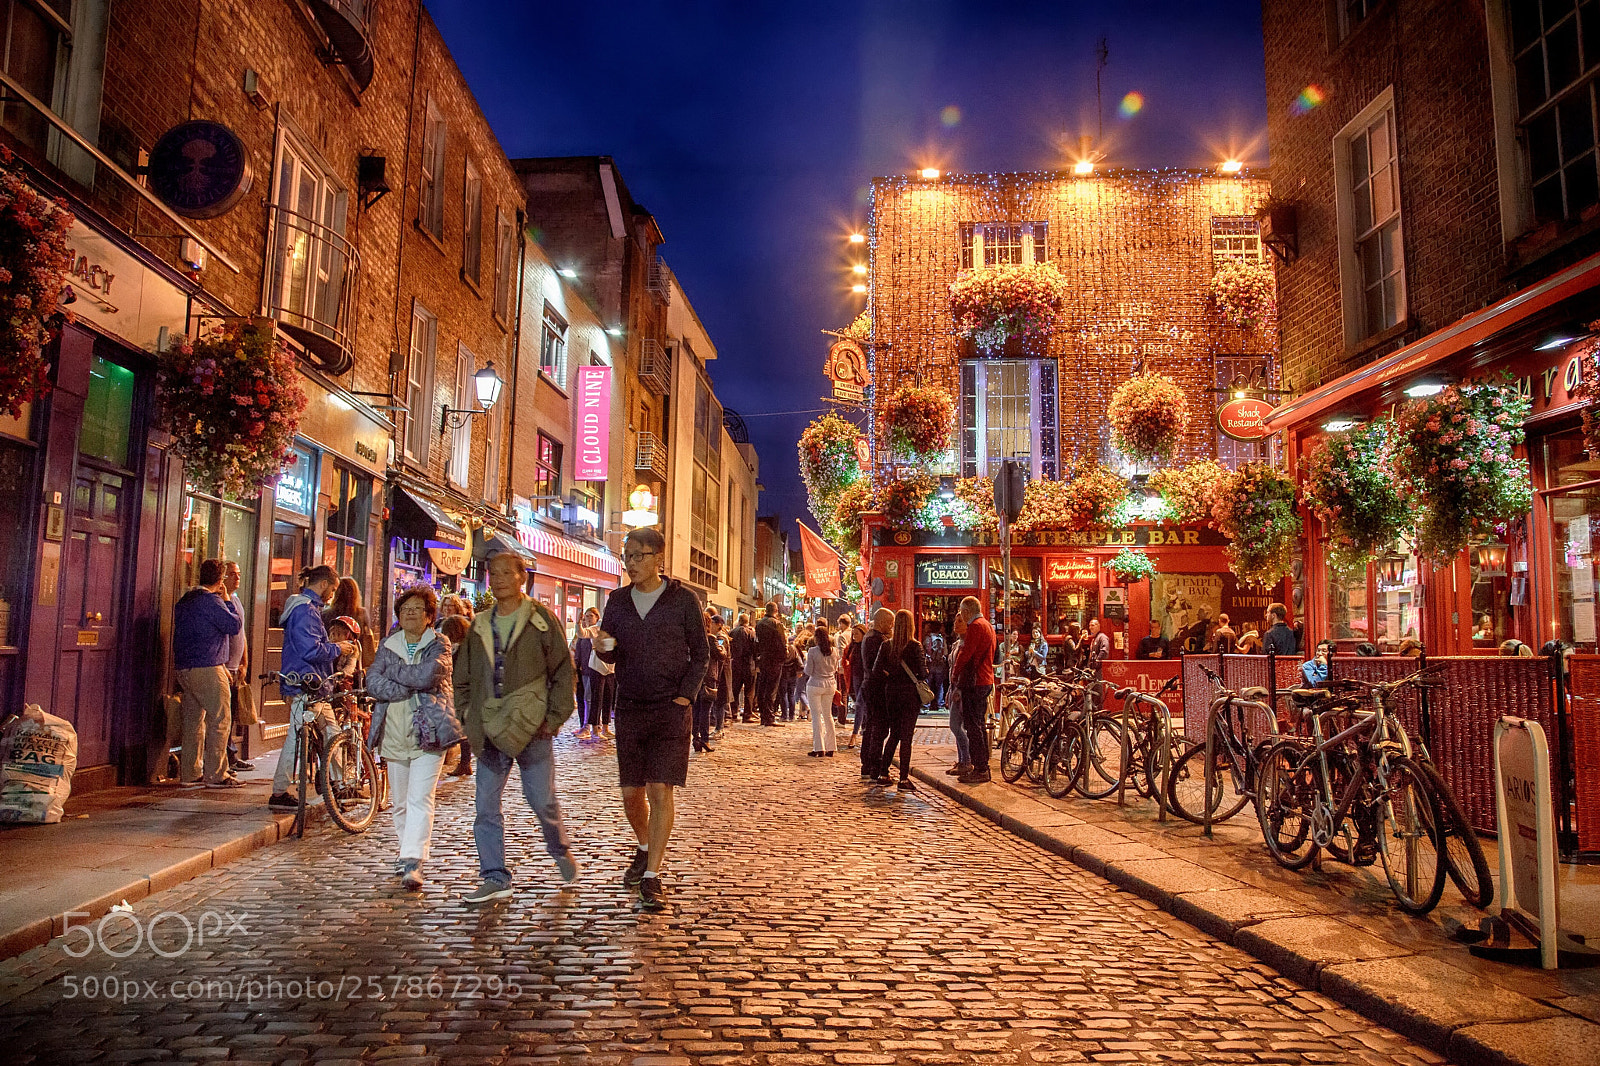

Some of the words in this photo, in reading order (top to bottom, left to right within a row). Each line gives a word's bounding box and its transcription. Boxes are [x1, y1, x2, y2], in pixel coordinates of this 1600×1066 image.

[585, 370, 605, 408] NINE
[1237, 405, 1261, 418] Shack
[1227, 419, 1263, 428] Restaura
[583, 413, 602, 464] CLOUD
[1035, 530, 1136, 545] TEMPLE
[1147, 530, 1200, 545] BAR
[1050, 561, 1095, 571] Traditional
[808, 570, 837, 579] TEMPLE
[923, 567, 970, 583] TOBACCO
[1049, 570, 1071, 580] Irish
[1072, 570, 1097, 580] Music
[1177, 578, 1219, 587] TEMPLE
[1188, 586, 1210, 596] BAR
[1232, 596, 1274, 608] EMPEROR
[13, 743, 58, 756] WASTE
[9, 749, 56, 765] BAG
